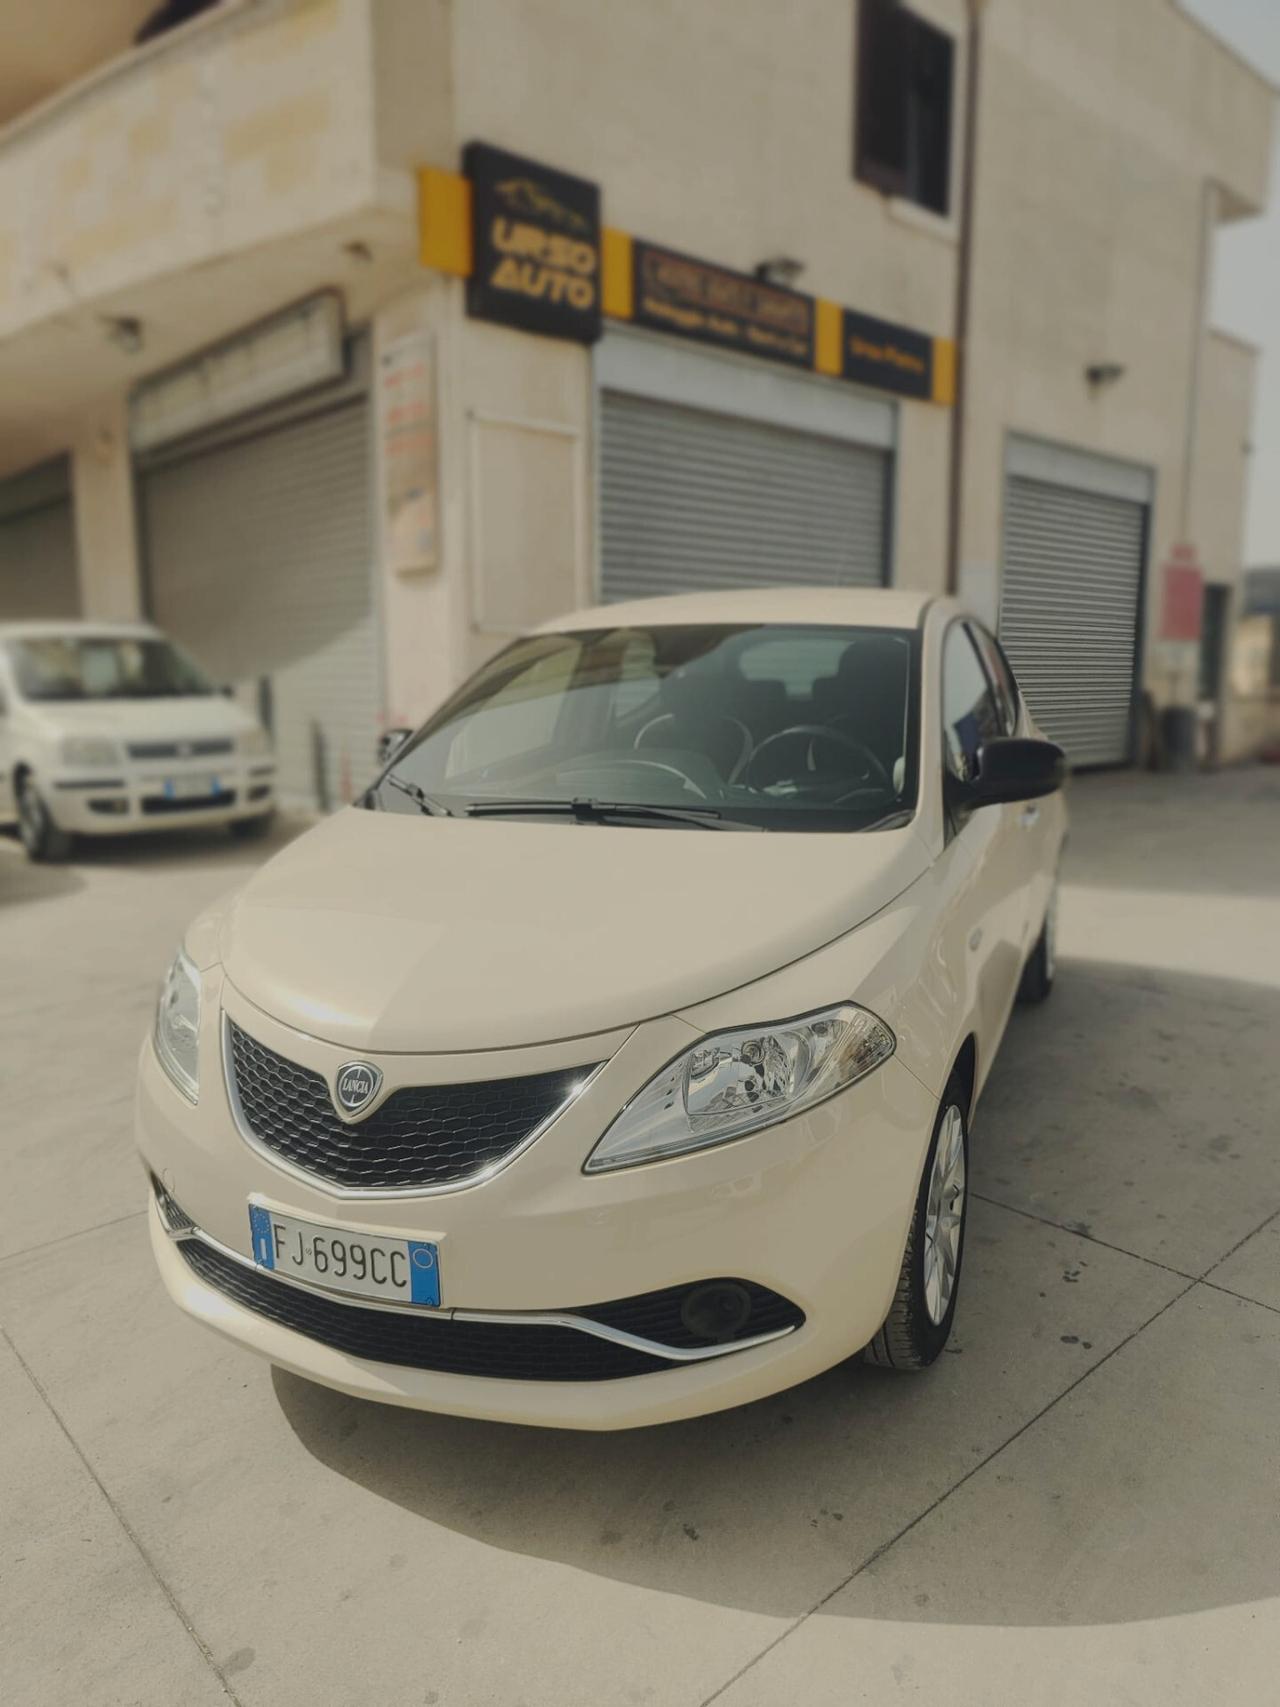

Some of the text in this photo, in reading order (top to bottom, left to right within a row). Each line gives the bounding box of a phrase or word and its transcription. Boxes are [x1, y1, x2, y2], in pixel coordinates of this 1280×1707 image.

[493, 217, 595, 274] URSO
[491, 259, 594, 309] AUTO
[342, 1077, 369, 1095] LANCIA
